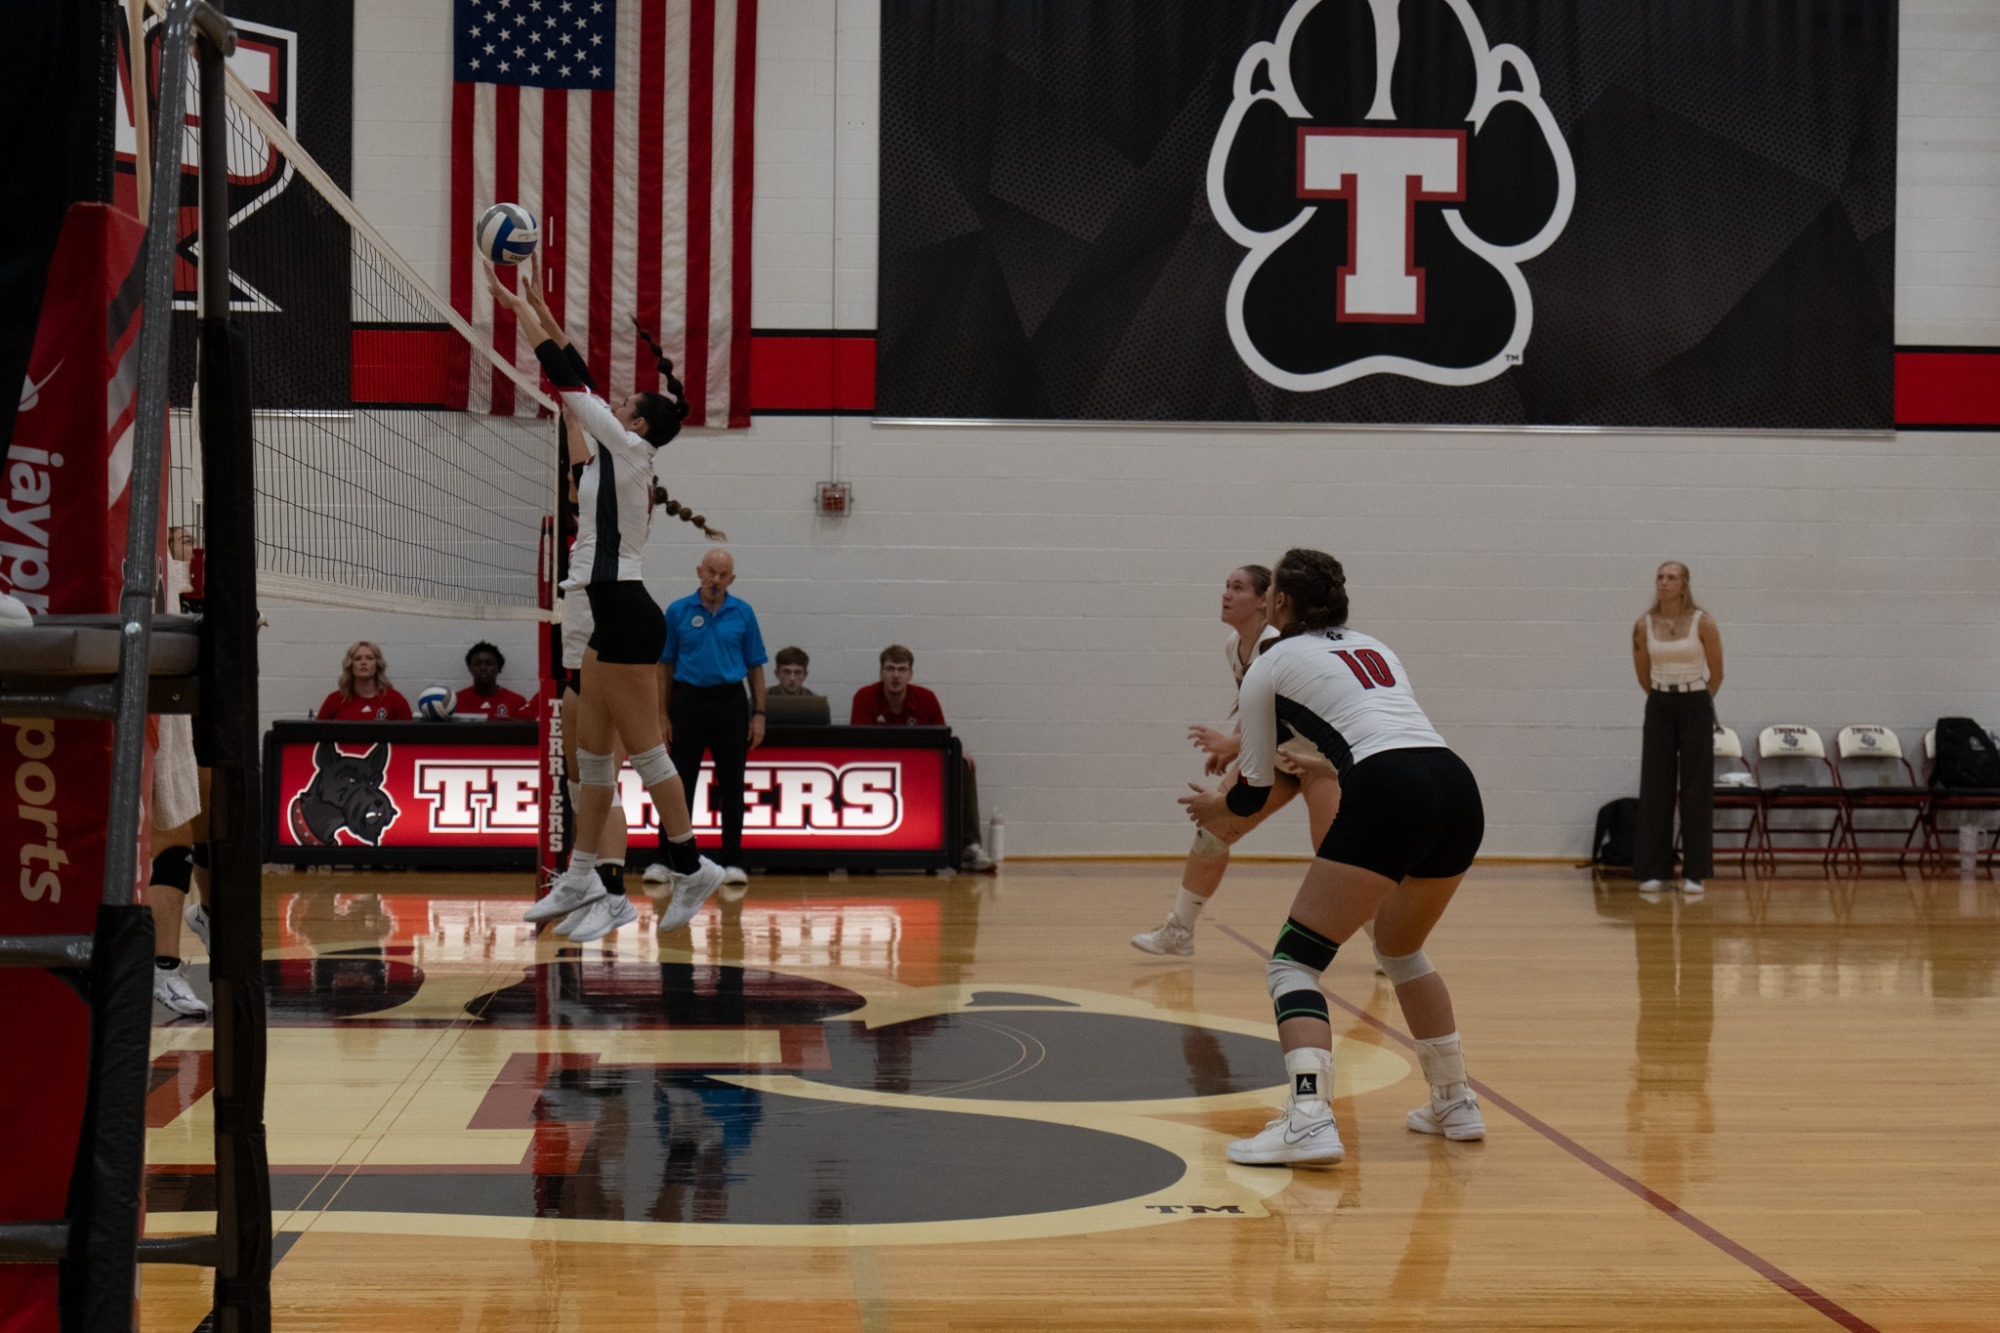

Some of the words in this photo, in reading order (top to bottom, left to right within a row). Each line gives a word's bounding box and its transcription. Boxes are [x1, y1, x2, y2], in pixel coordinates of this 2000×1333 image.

[1296, 126, 1467, 323] T
[1505, 354, 1520, 362] TM
[1328, 648, 1396, 690] 10
[548, 698, 564, 852] TERRIERS
[1144, 1205, 1245, 1214] TM
